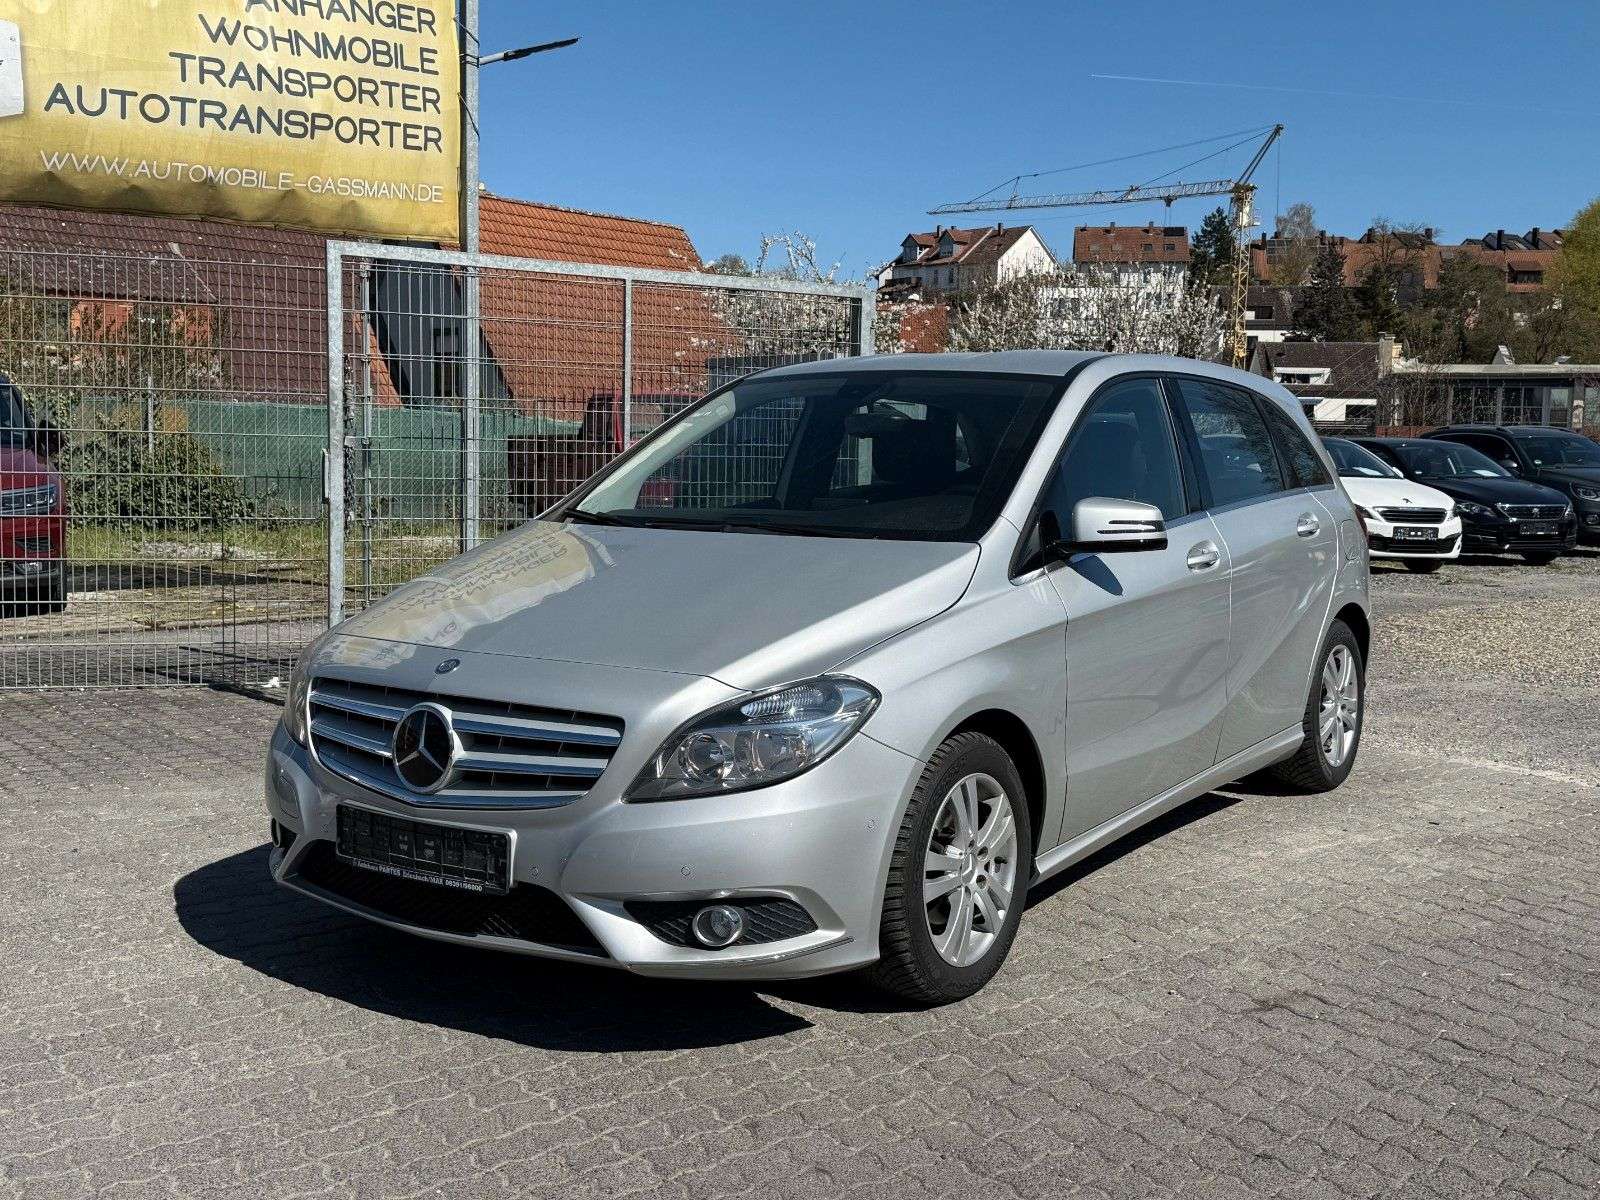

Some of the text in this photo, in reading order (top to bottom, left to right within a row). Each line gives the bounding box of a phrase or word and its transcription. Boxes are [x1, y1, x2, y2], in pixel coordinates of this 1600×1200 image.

[198, 14, 439, 76] WOHNMOBILE
[168, 51, 441, 114] TRANSPORTER
[44, 83, 442, 153] AUTOTRANSPORTER
[40, 150, 444, 203] WWW.AUTOMOBILE-GASSMANN.DE
